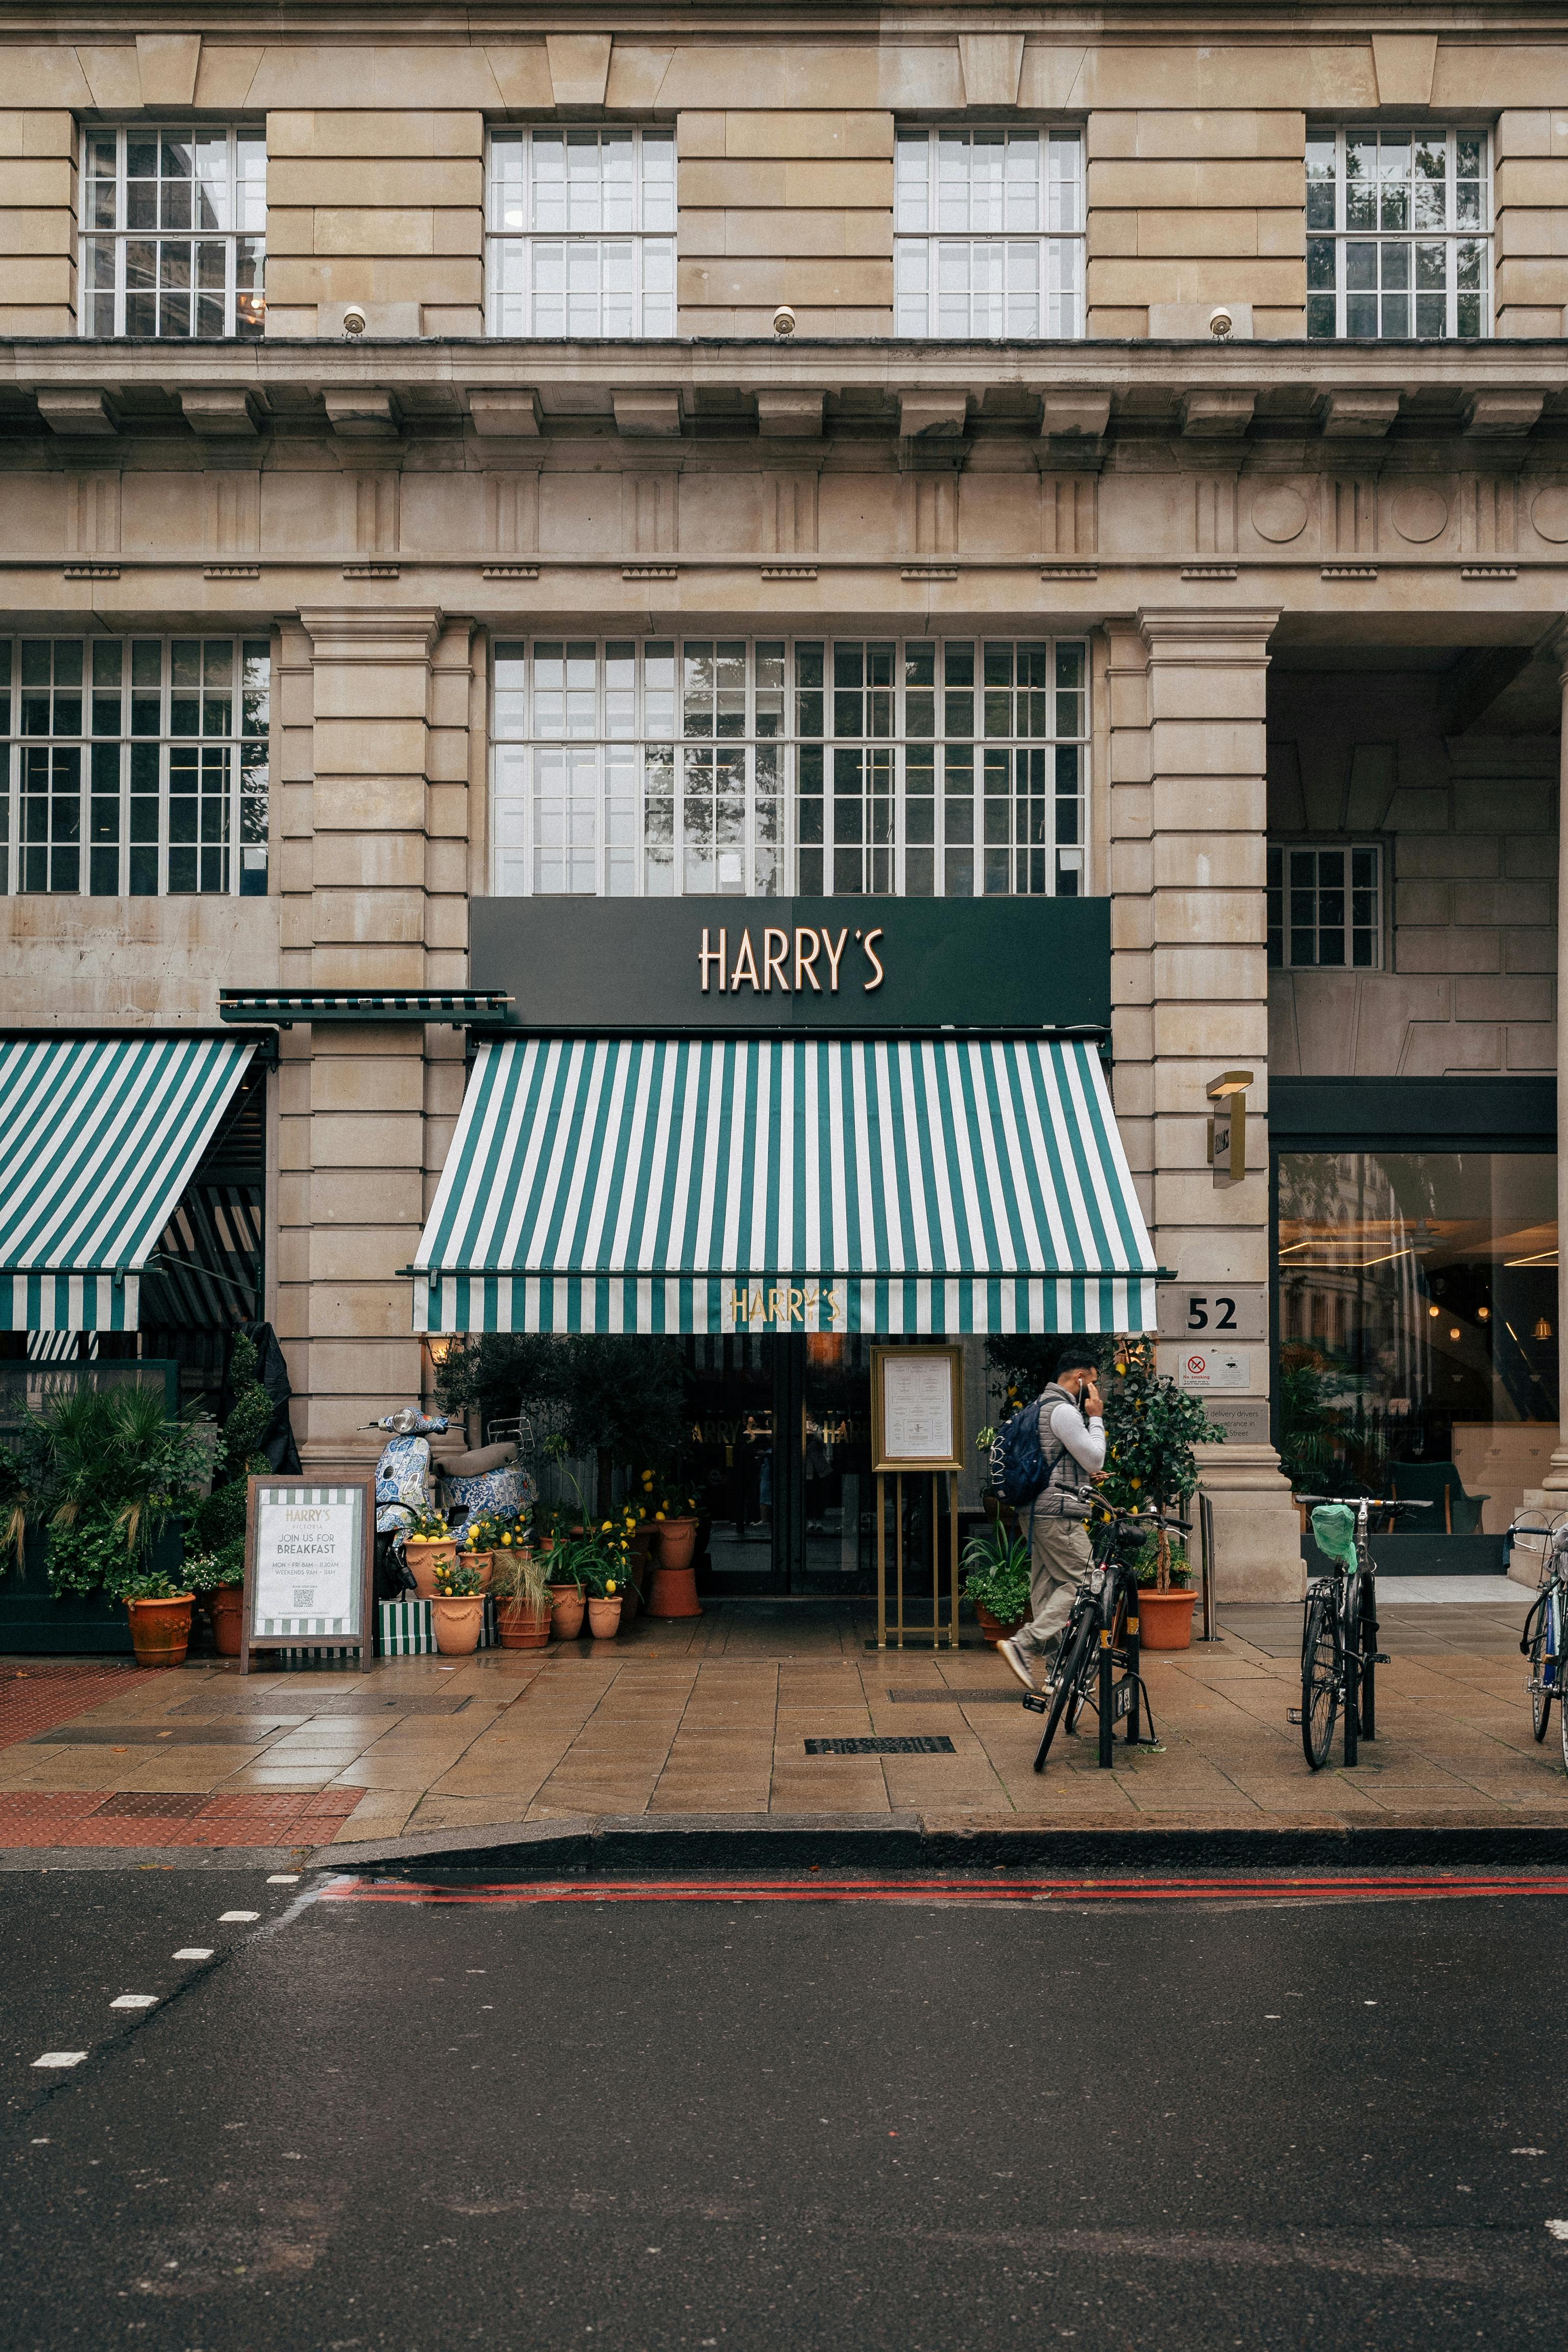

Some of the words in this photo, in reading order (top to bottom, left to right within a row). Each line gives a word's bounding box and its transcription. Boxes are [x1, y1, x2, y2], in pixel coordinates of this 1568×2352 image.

[698, 926, 884, 992] HARRY'S
[729, 1288, 841, 1322] HARRY'S
[1187, 1297, 1237, 1330] 52
[1210, 1410, 1235, 1418] delivery
[285, 1509, 331, 1522] HARRY'S
[279, 1534, 299, 1542] JOIN
[303, 1534, 313, 1542] US
[317, 1534, 334, 1542] FOR
[277, 1544, 335, 1554] BREAKFAST
